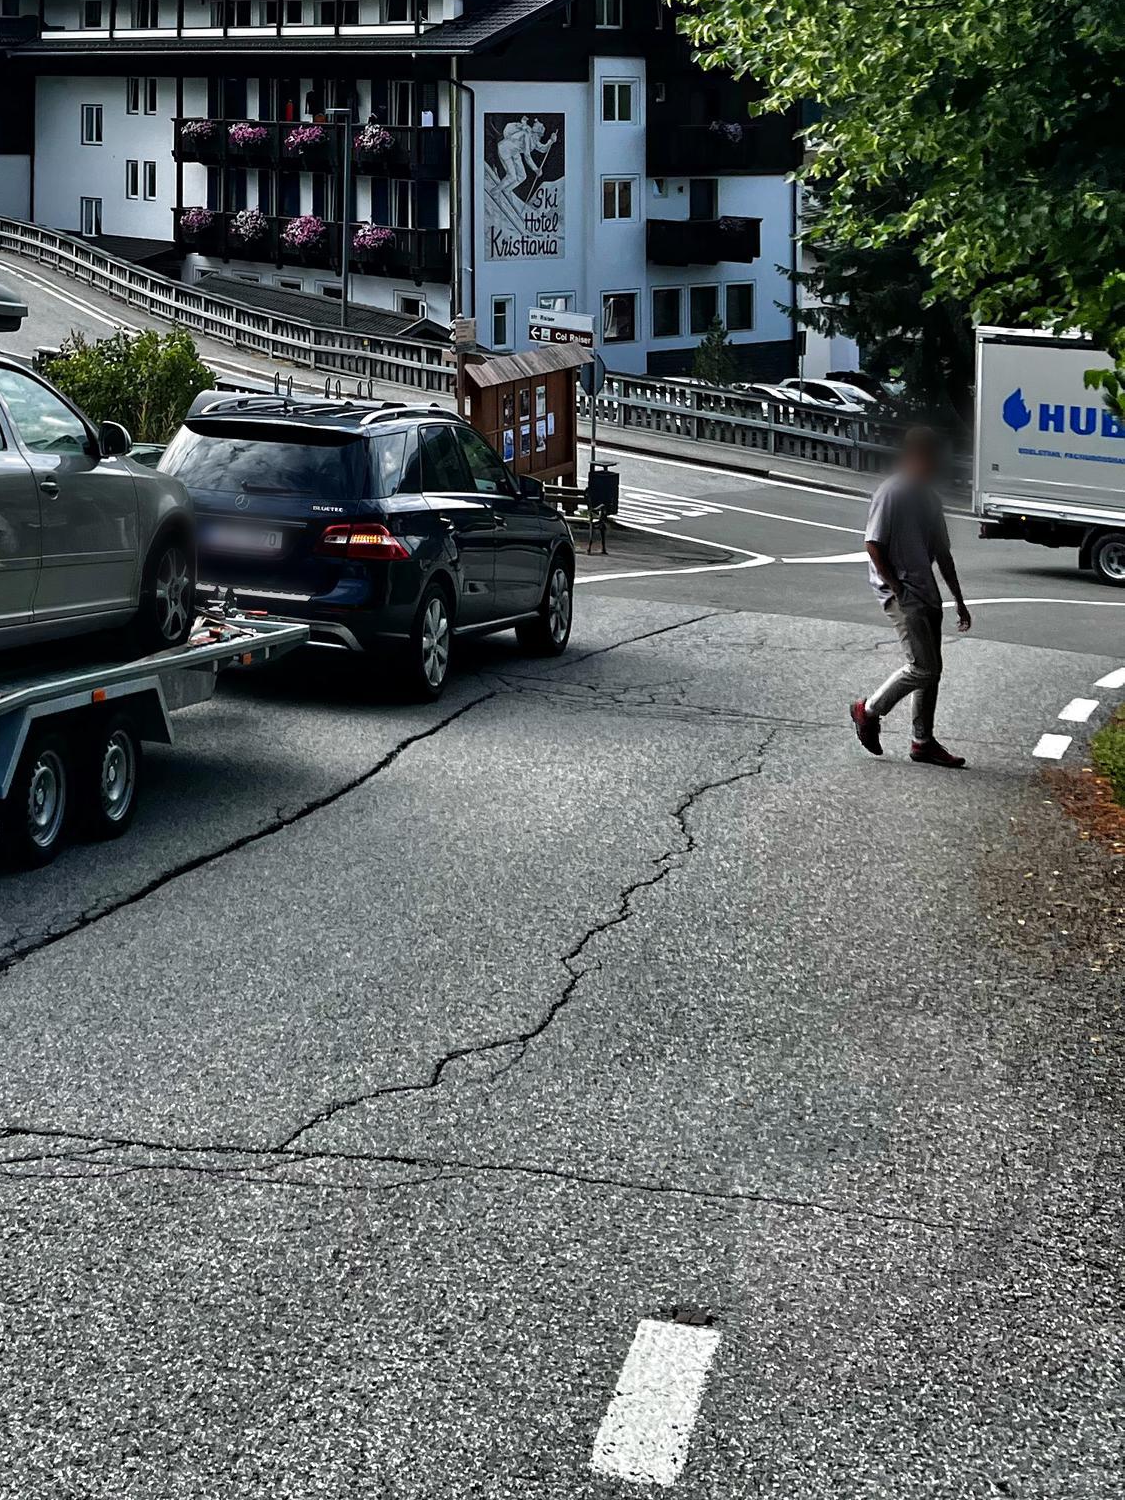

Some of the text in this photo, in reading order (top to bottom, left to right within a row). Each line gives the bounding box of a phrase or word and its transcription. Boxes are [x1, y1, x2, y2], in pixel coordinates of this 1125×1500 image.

[532, 187, 558, 209] Ski
[524, 211, 559, 233] Hotel
[490, 225, 558, 258] Kristiania
[555, 331, 592, 345] Col Raiser
